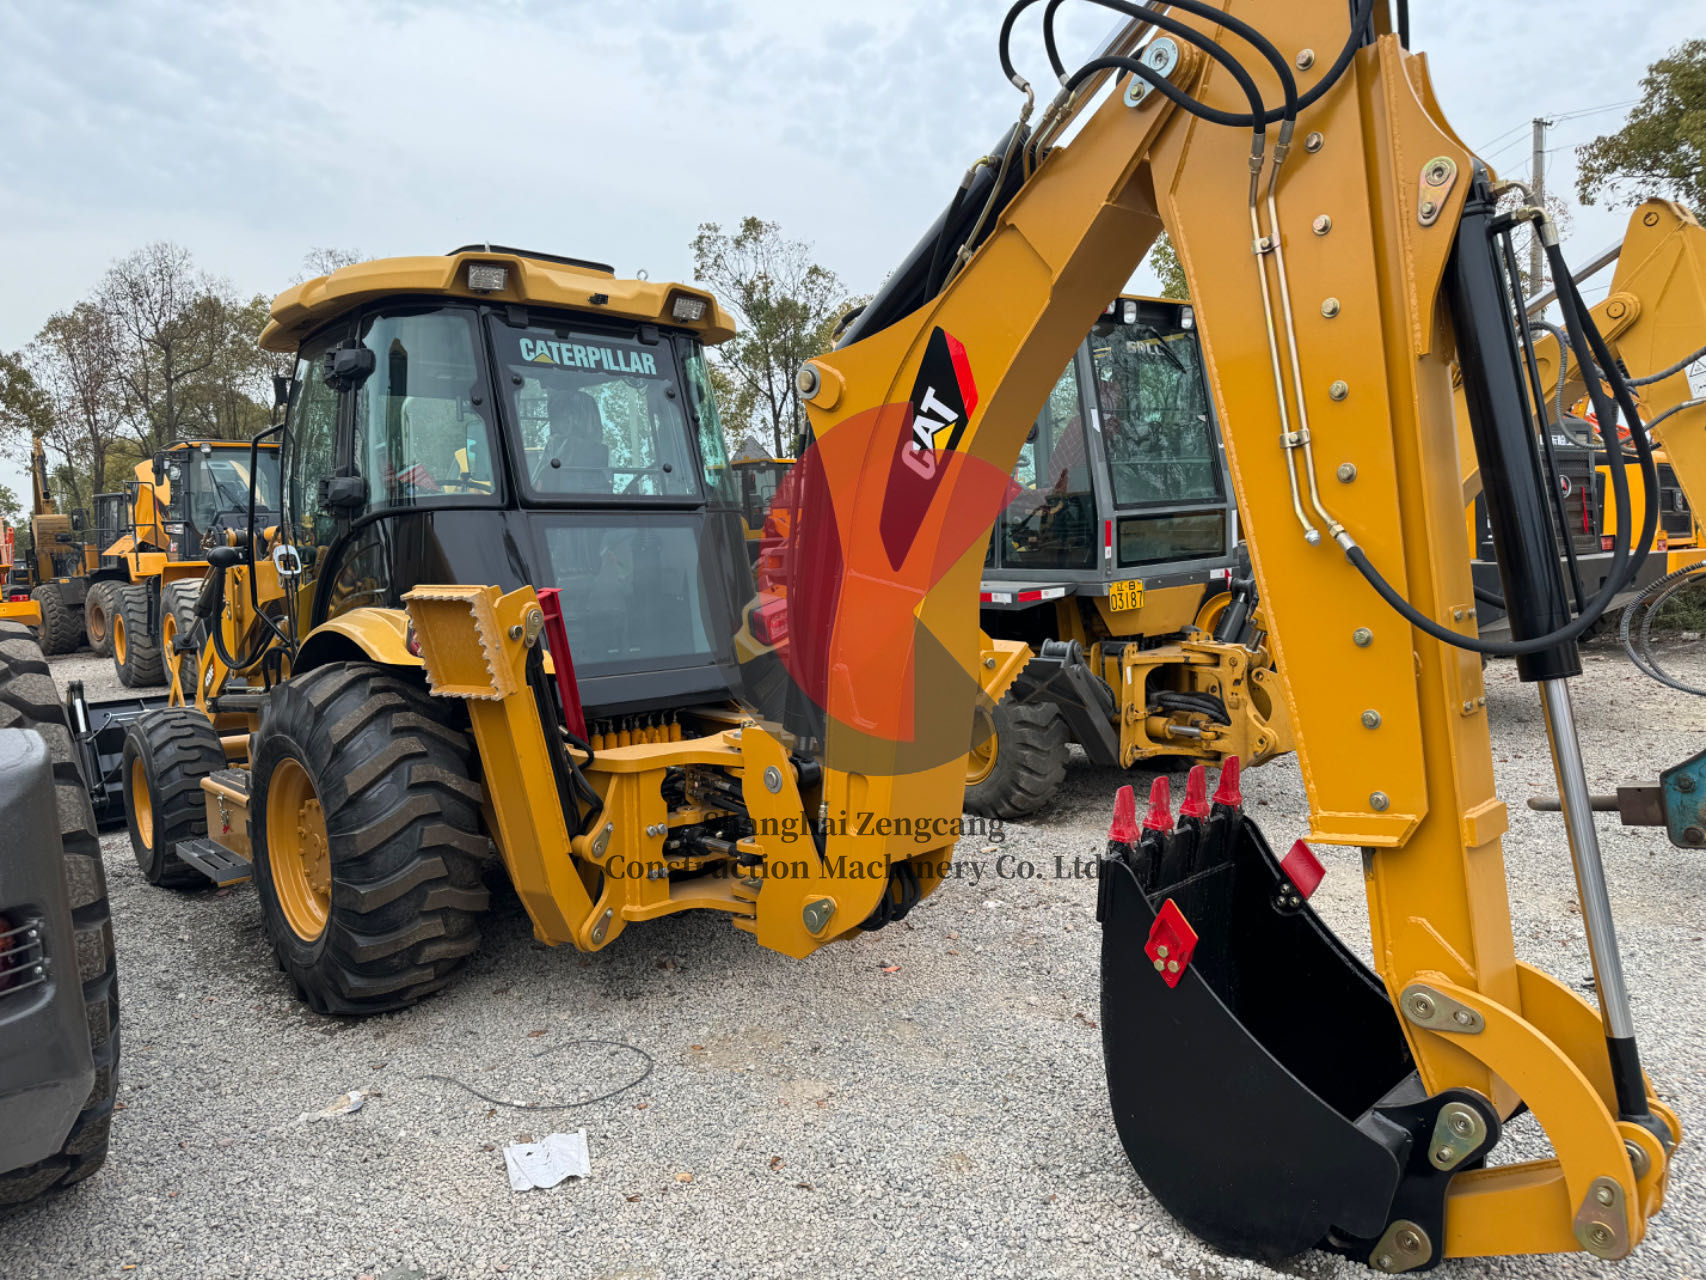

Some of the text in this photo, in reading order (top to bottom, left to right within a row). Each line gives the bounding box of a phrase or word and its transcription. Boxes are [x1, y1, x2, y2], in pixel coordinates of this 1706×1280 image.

[519, 337, 657, 375] CATERPILLAR
[901, 386, 959, 480] CAT
[1111, 590, 1143, 610] 03187
